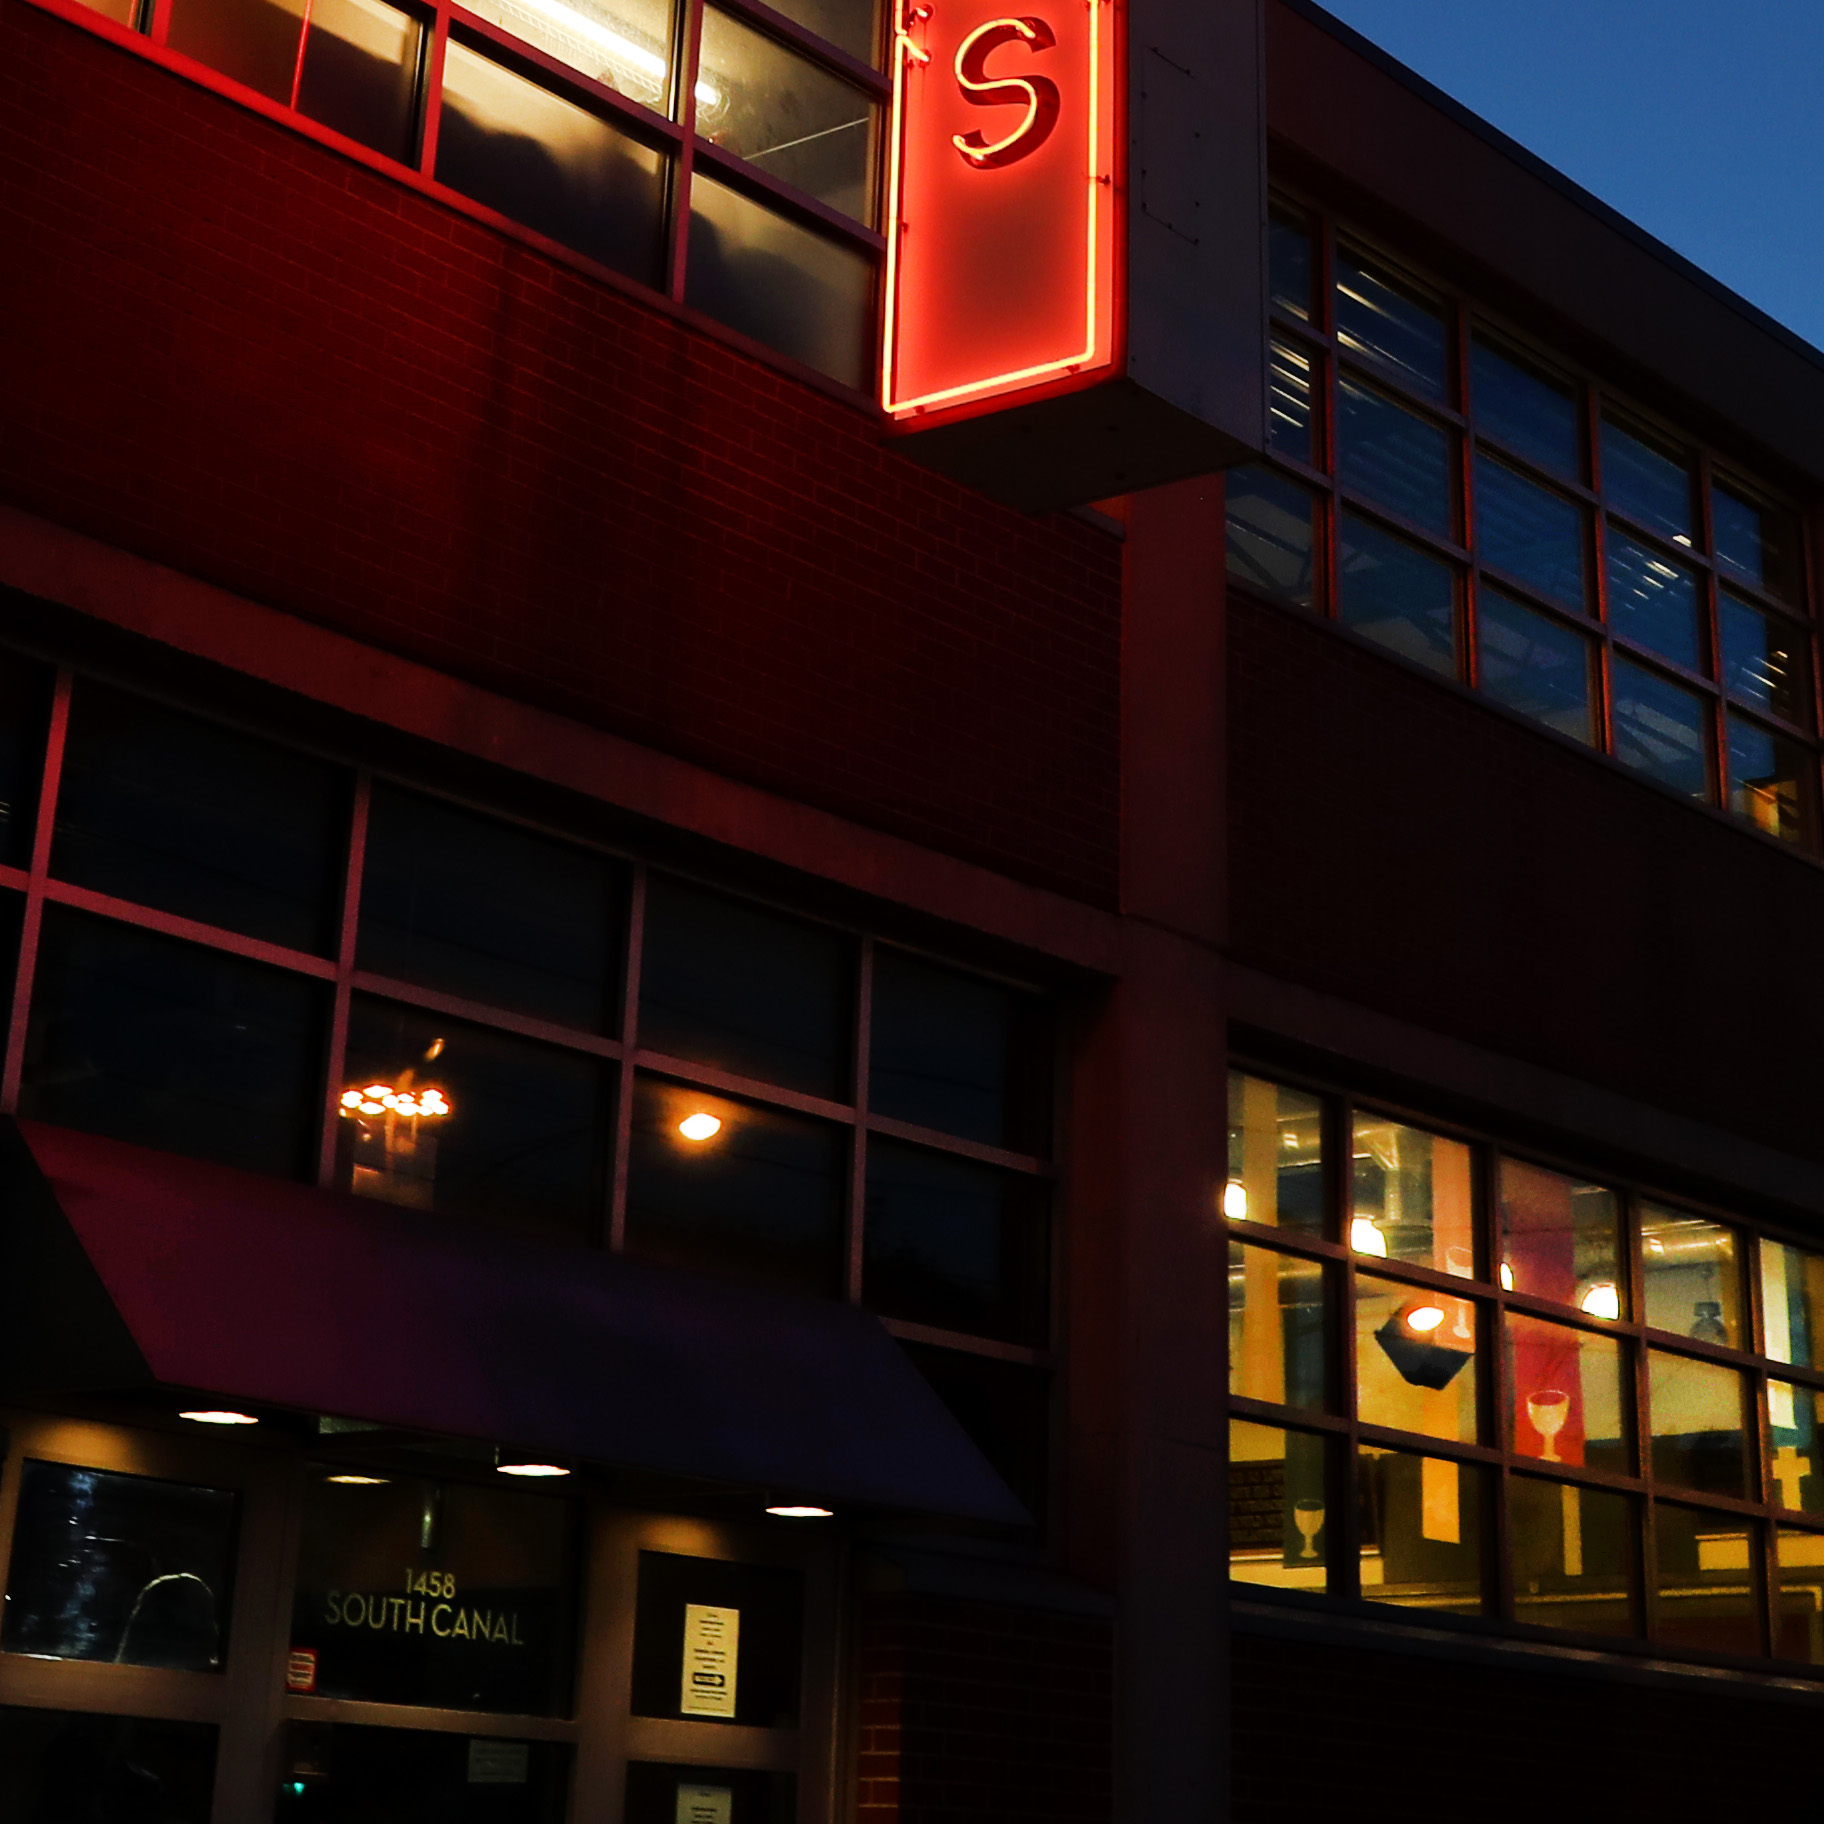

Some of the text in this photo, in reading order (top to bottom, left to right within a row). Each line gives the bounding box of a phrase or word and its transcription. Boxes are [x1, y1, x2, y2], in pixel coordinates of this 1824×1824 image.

[405, 1567, 457, 1600] 1458
[324, 1588, 526, 1646] SOUTH CANAL
